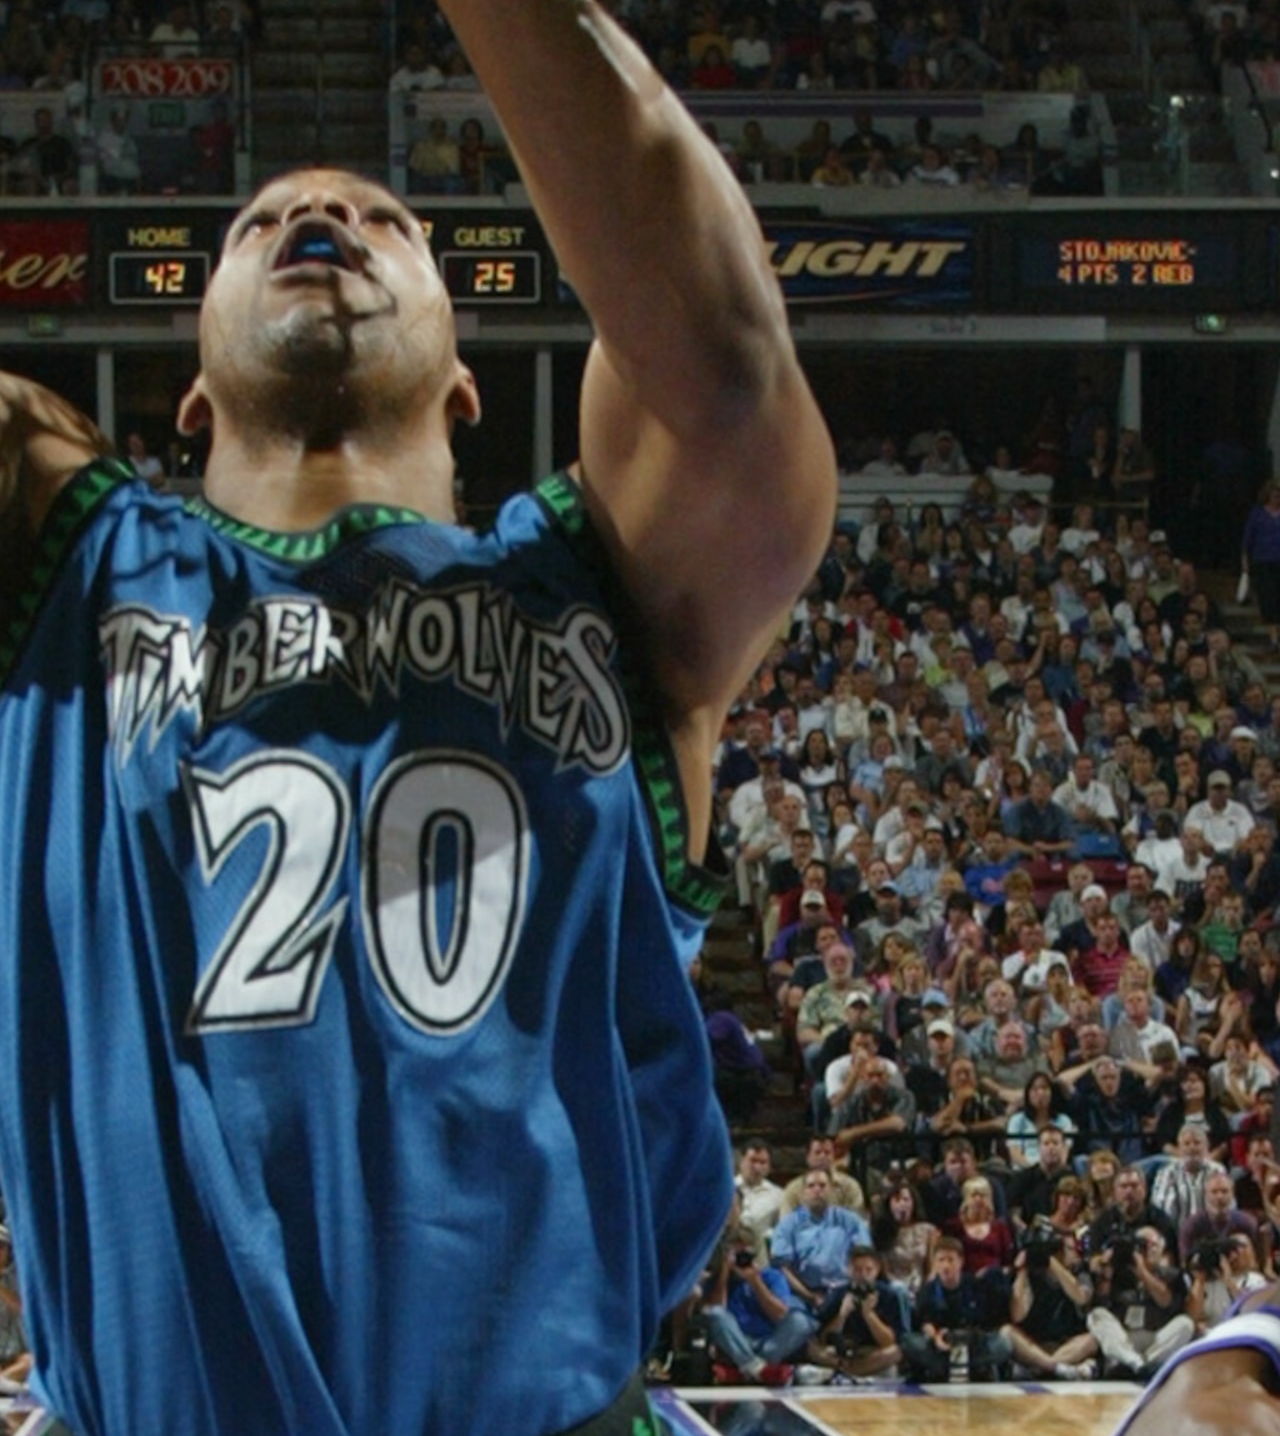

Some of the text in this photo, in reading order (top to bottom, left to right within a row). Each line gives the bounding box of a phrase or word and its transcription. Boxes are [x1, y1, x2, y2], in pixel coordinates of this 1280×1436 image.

[128, 227, 191, 256] HOME
[454, 226, 526, 256] GUEST
[764, 240, 966, 278] LIGHT
[145, 261, 516, 304] 42 25
[1057, 264, 1195, 285] 4 PTS 2 REB
[99, 578, 630, 778] TIMBERWOLVES
[180, 747, 533, 1035] 20
